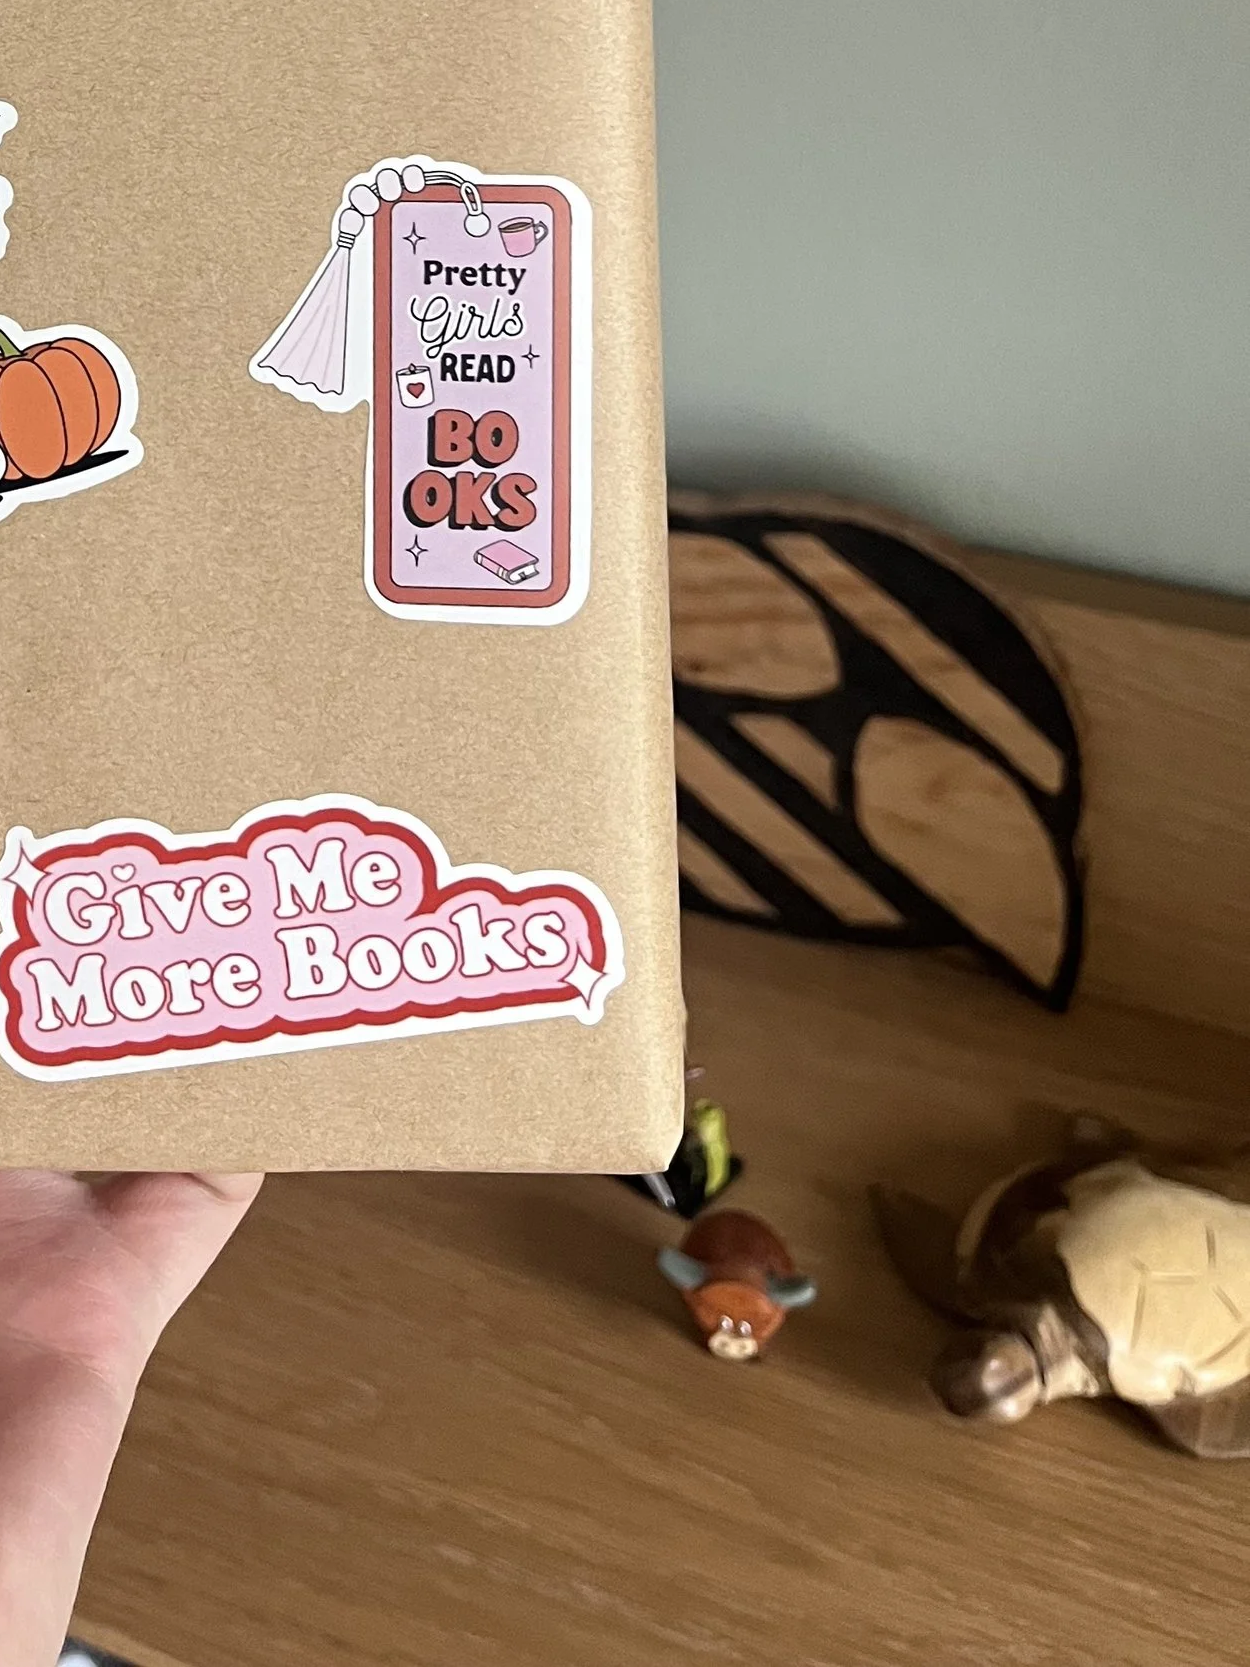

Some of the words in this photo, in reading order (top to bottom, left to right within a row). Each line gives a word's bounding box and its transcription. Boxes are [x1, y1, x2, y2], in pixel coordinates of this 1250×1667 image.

[423, 259, 527, 294] Pretty
[410, 295, 524, 359] Girls
[440, 352, 516, 383] READ
[427, 409, 520, 468] BO
[402, 470, 538, 532] OKS
[47, 864, 251, 946] Give
[264, 837, 402, 920] Me
[26, 951, 262, 1032] More
[276, 904, 570, 1001] Books
